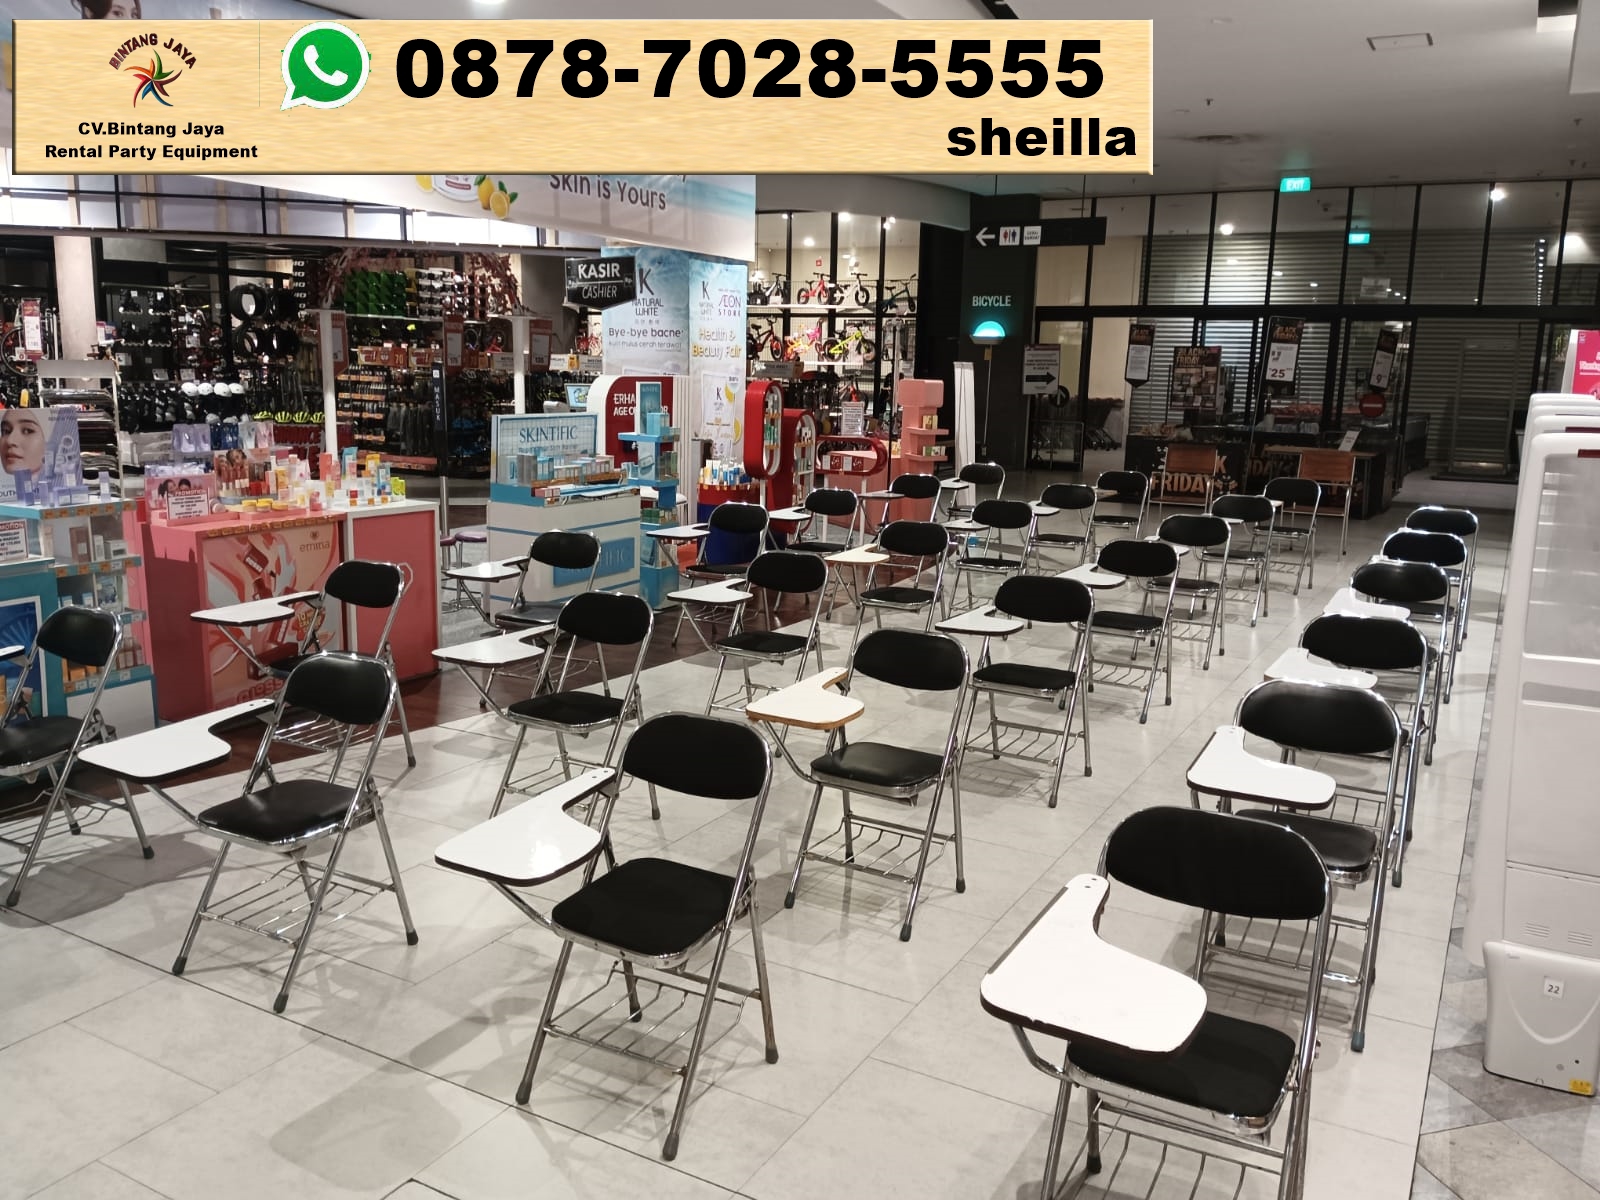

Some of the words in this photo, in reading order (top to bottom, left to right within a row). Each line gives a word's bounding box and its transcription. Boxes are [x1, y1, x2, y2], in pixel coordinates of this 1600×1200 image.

[597, 175, 611, 199] is
[617, 180, 666, 210] Yours
[578, 263, 620, 278] KASIR
[638, 268, 654, 296] K
[582, 285, 617, 299] CASHIER
[702, 280, 711, 300] K
[632, 299, 664, 308] NATURAL
[972, 295, 1012, 307] BICYCLE
[635, 307, 659, 317] WHITE
[698, 328, 728, 342] Health
[692, 343, 724, 359] Beauty
[726, 345, 742, 358] Fair
[613, 407, 629, 416] AGE
[519, 425, 577, 443] SKINTIFIC
[1152, 474, 1214, 493] FRIDAY
[299, 541, 330, 552] emina
[1547, 984, 1560, 995] 22
